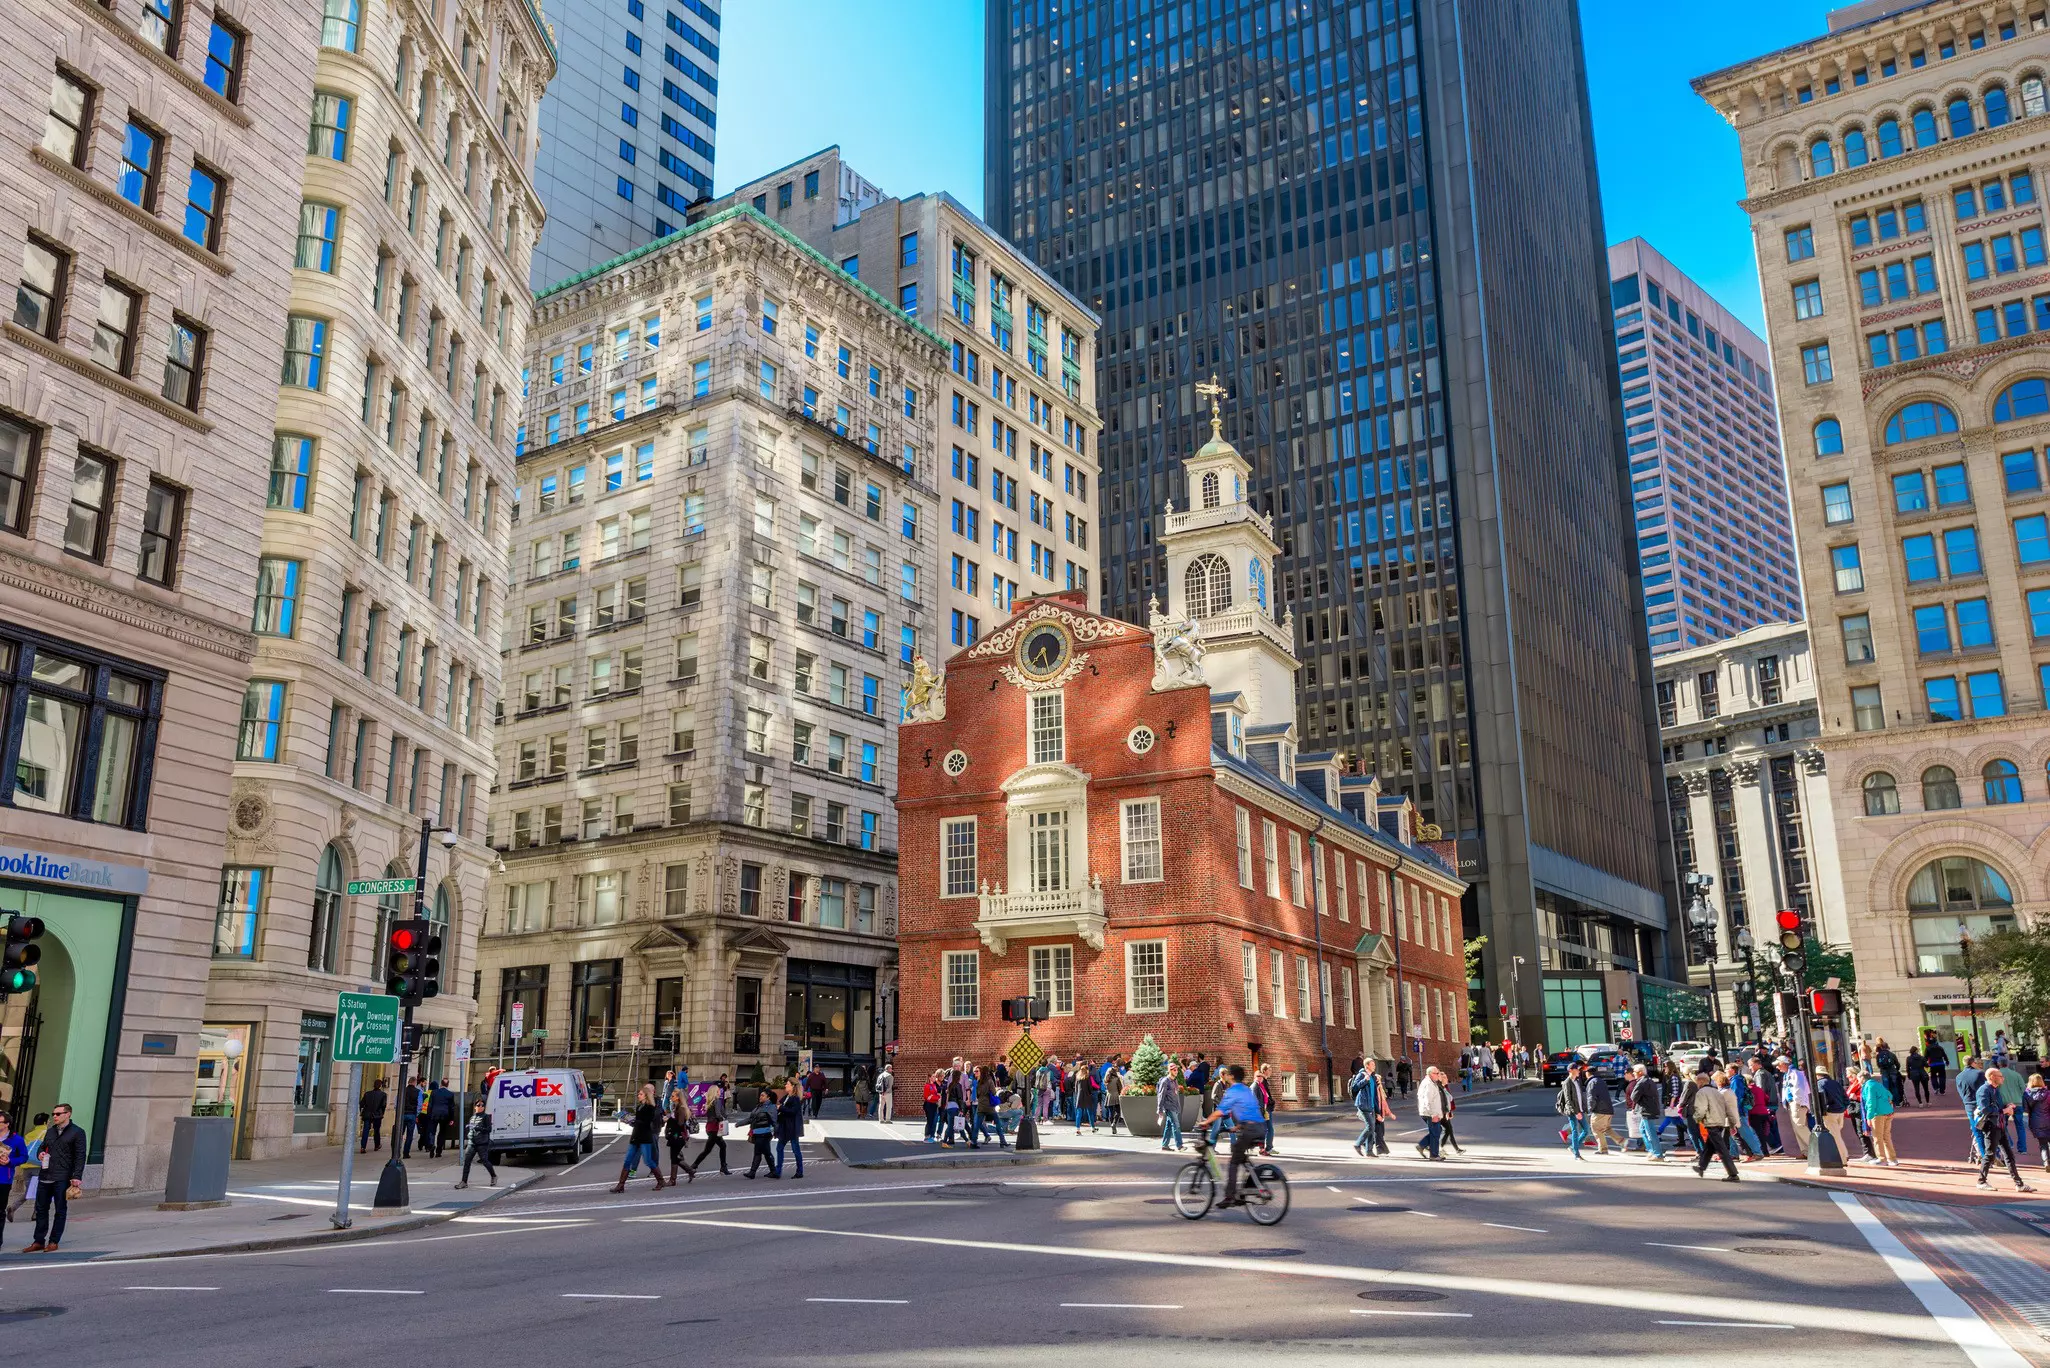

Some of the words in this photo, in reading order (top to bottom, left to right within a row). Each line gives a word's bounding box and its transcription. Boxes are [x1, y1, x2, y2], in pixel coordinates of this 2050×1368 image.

[359, 880, 405, 893] CONGRESS
[341, 999, 347, 1008] S.
[347, 999, 367, 1010] Station
[366, 1011, 394, 1021] Downtown
[366, 1021, 390, 1033] Crossing
[366, 1034, 392, 1045] Government
[365, 1045, 382, 1055] Center
[498, 1078, 563, 1099] FedEx
